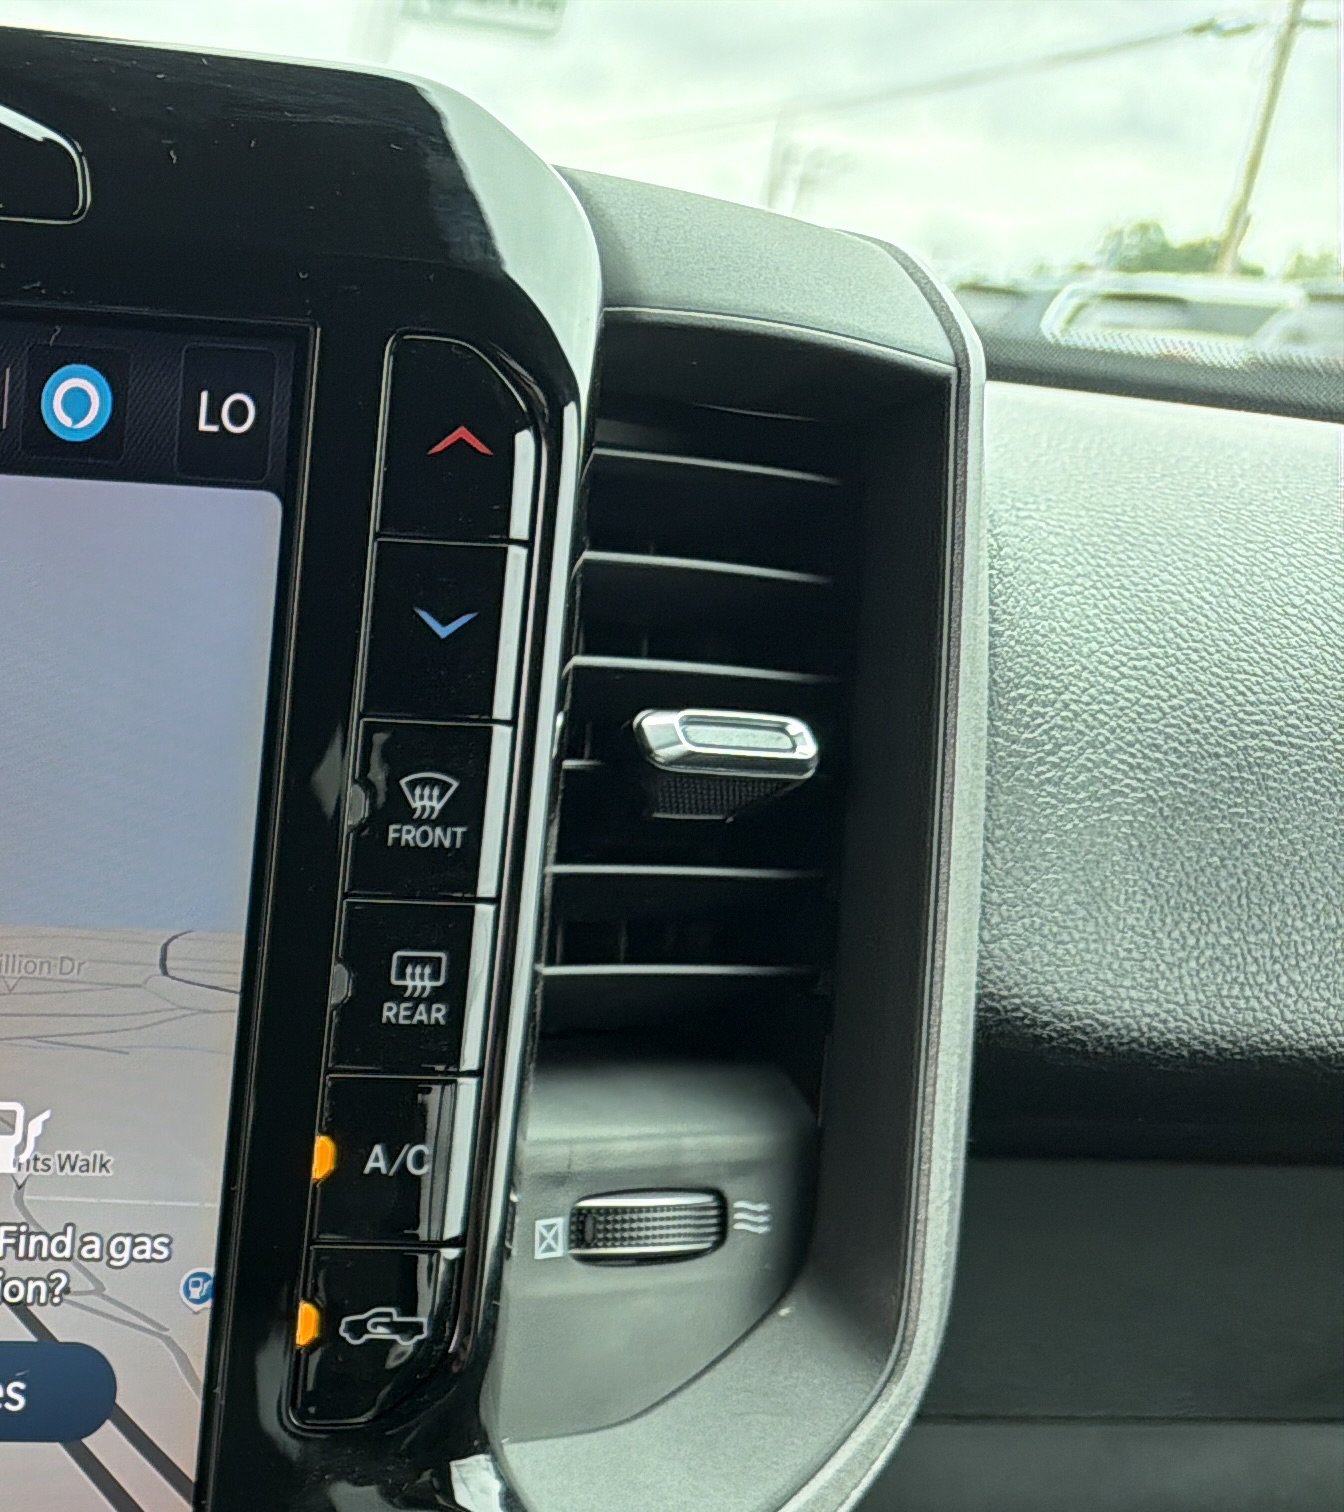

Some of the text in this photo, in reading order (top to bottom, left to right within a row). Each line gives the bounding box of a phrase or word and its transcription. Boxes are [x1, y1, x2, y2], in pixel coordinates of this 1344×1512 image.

[198, 390, 256, 434] LO
[386, 824, 467, 849] FRONT
[58, 954, 85, 977] Dr
[381, 1002, 447, 1027] REAR
[57, 1153, 112, 1174] Walk
[363, 1144, 431, 1176] A/C
[79, 1236, 101, 1260] a
[109, 1233, 170, 1265] gas
